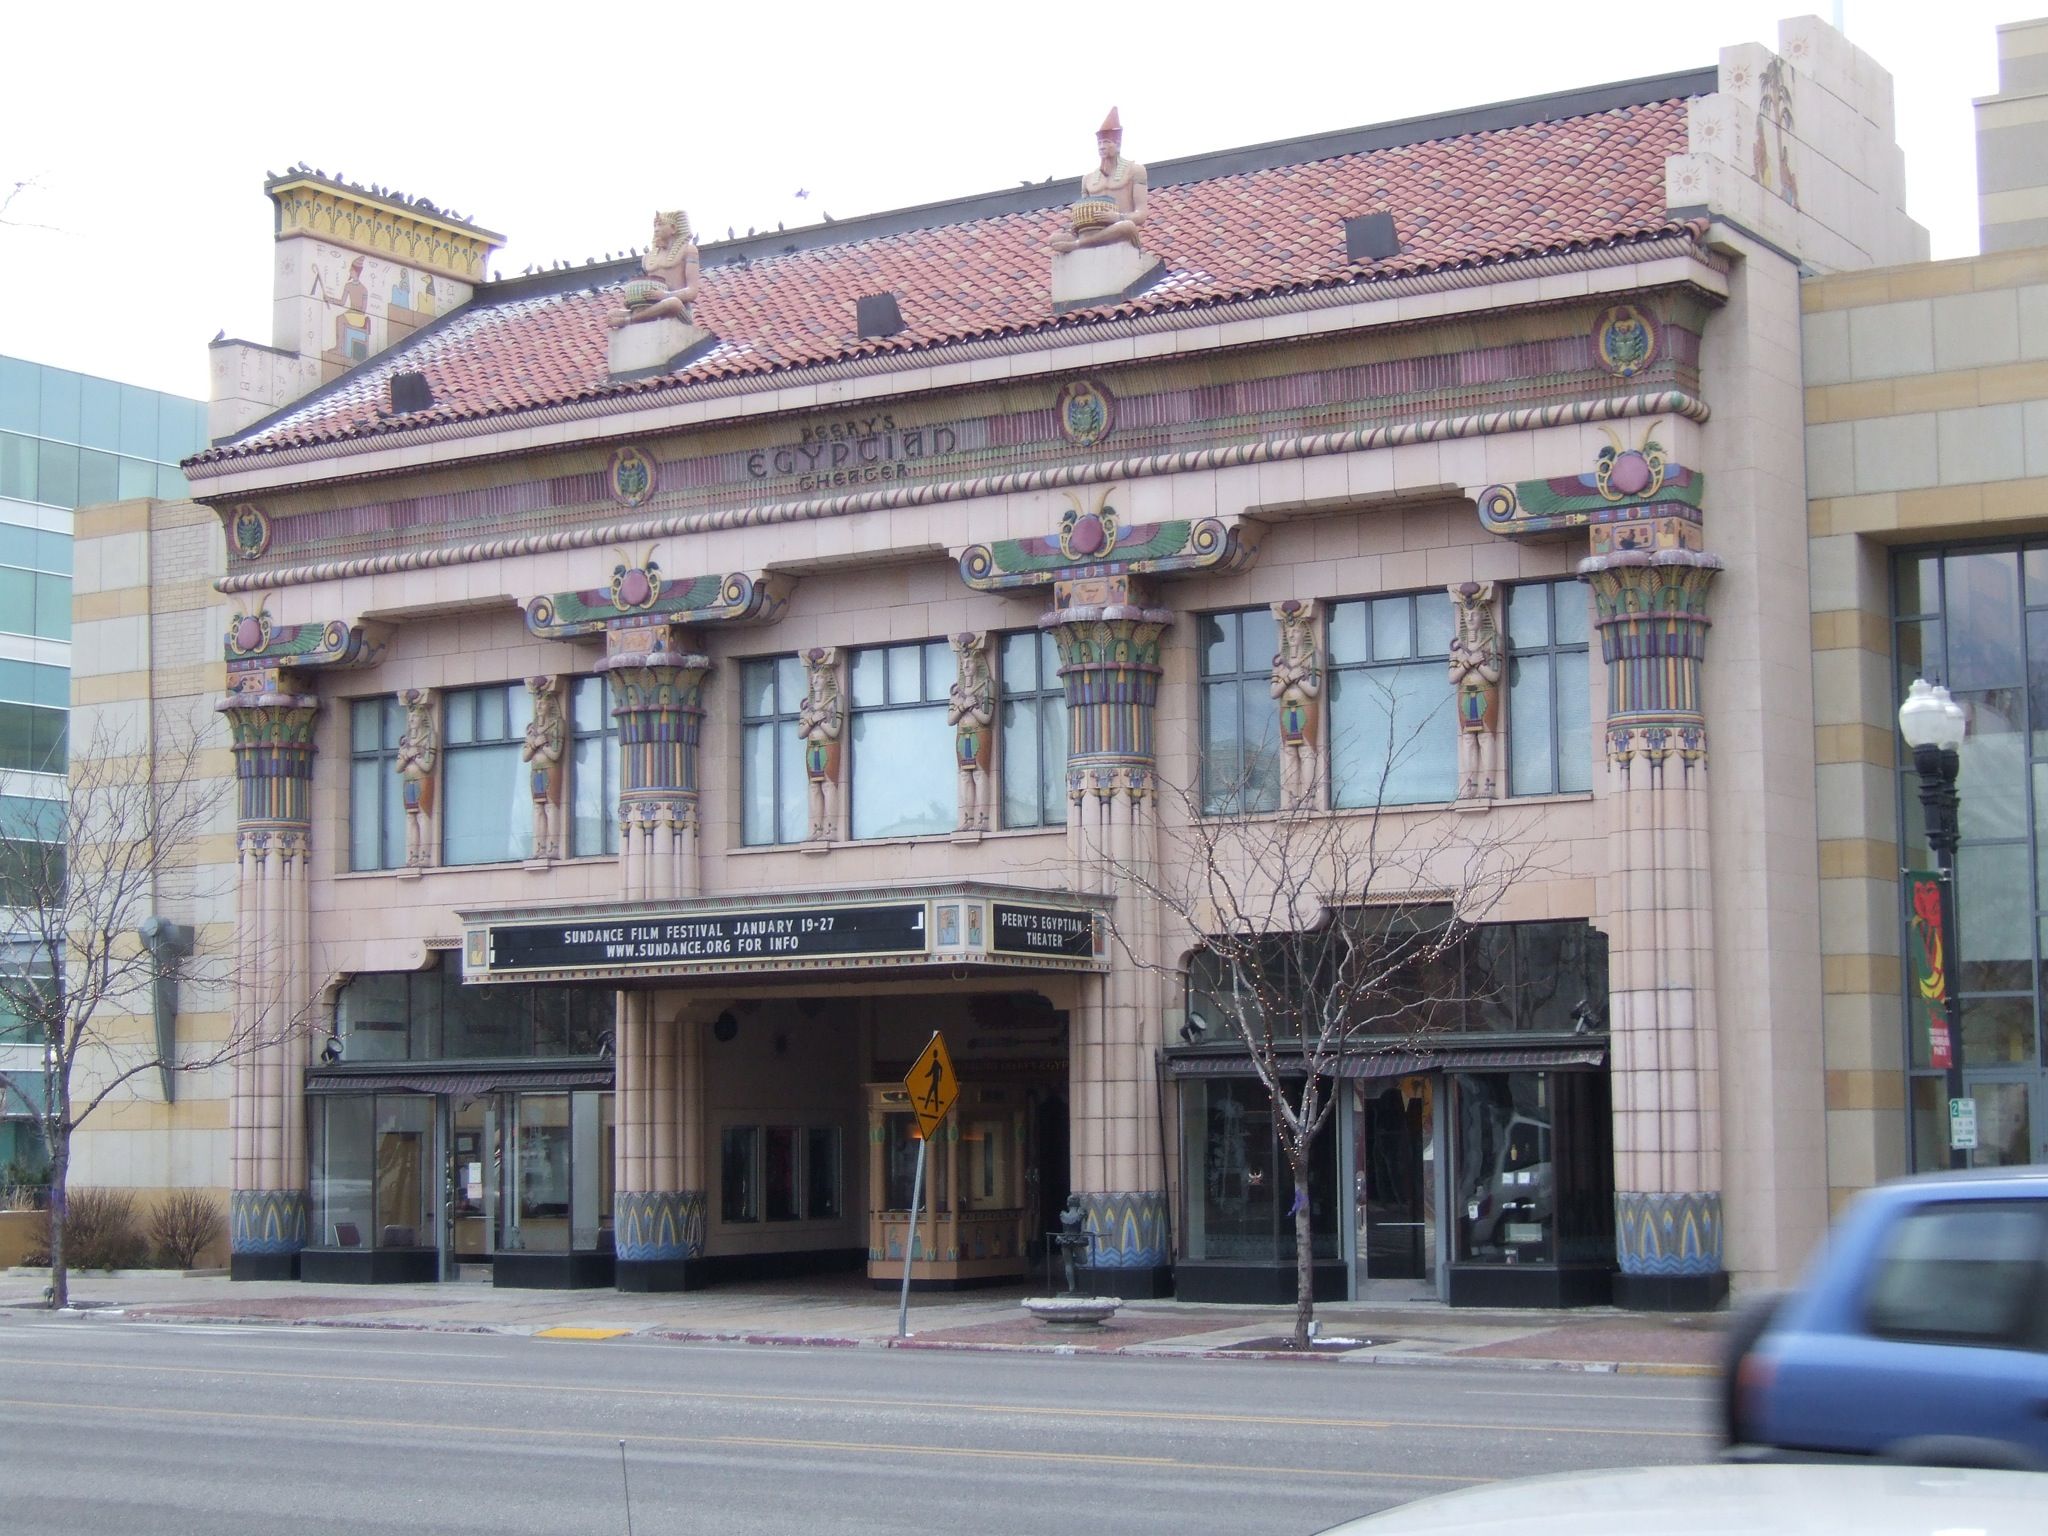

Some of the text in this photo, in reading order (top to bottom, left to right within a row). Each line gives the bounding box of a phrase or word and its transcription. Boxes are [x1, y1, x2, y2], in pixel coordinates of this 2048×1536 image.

[802, 413, 896, 442] PEERY'S
[747, 428, 956, 478] EGYPTIAN
[799, 463, 909, 491] THEATER
[564, 917, 835, 945] SUNDANCE FILM FESTIVAL JANUARY 19-27
[1001, 912, 1082, 933] PEERY'S EGYPTIAN
[606, 936, 799, 958] WWW.SUNDANCE.ORG FOR INFO
[1026, 931, 1063, 947] THEATER
[1952, 1102, 1959, 1116] 2
